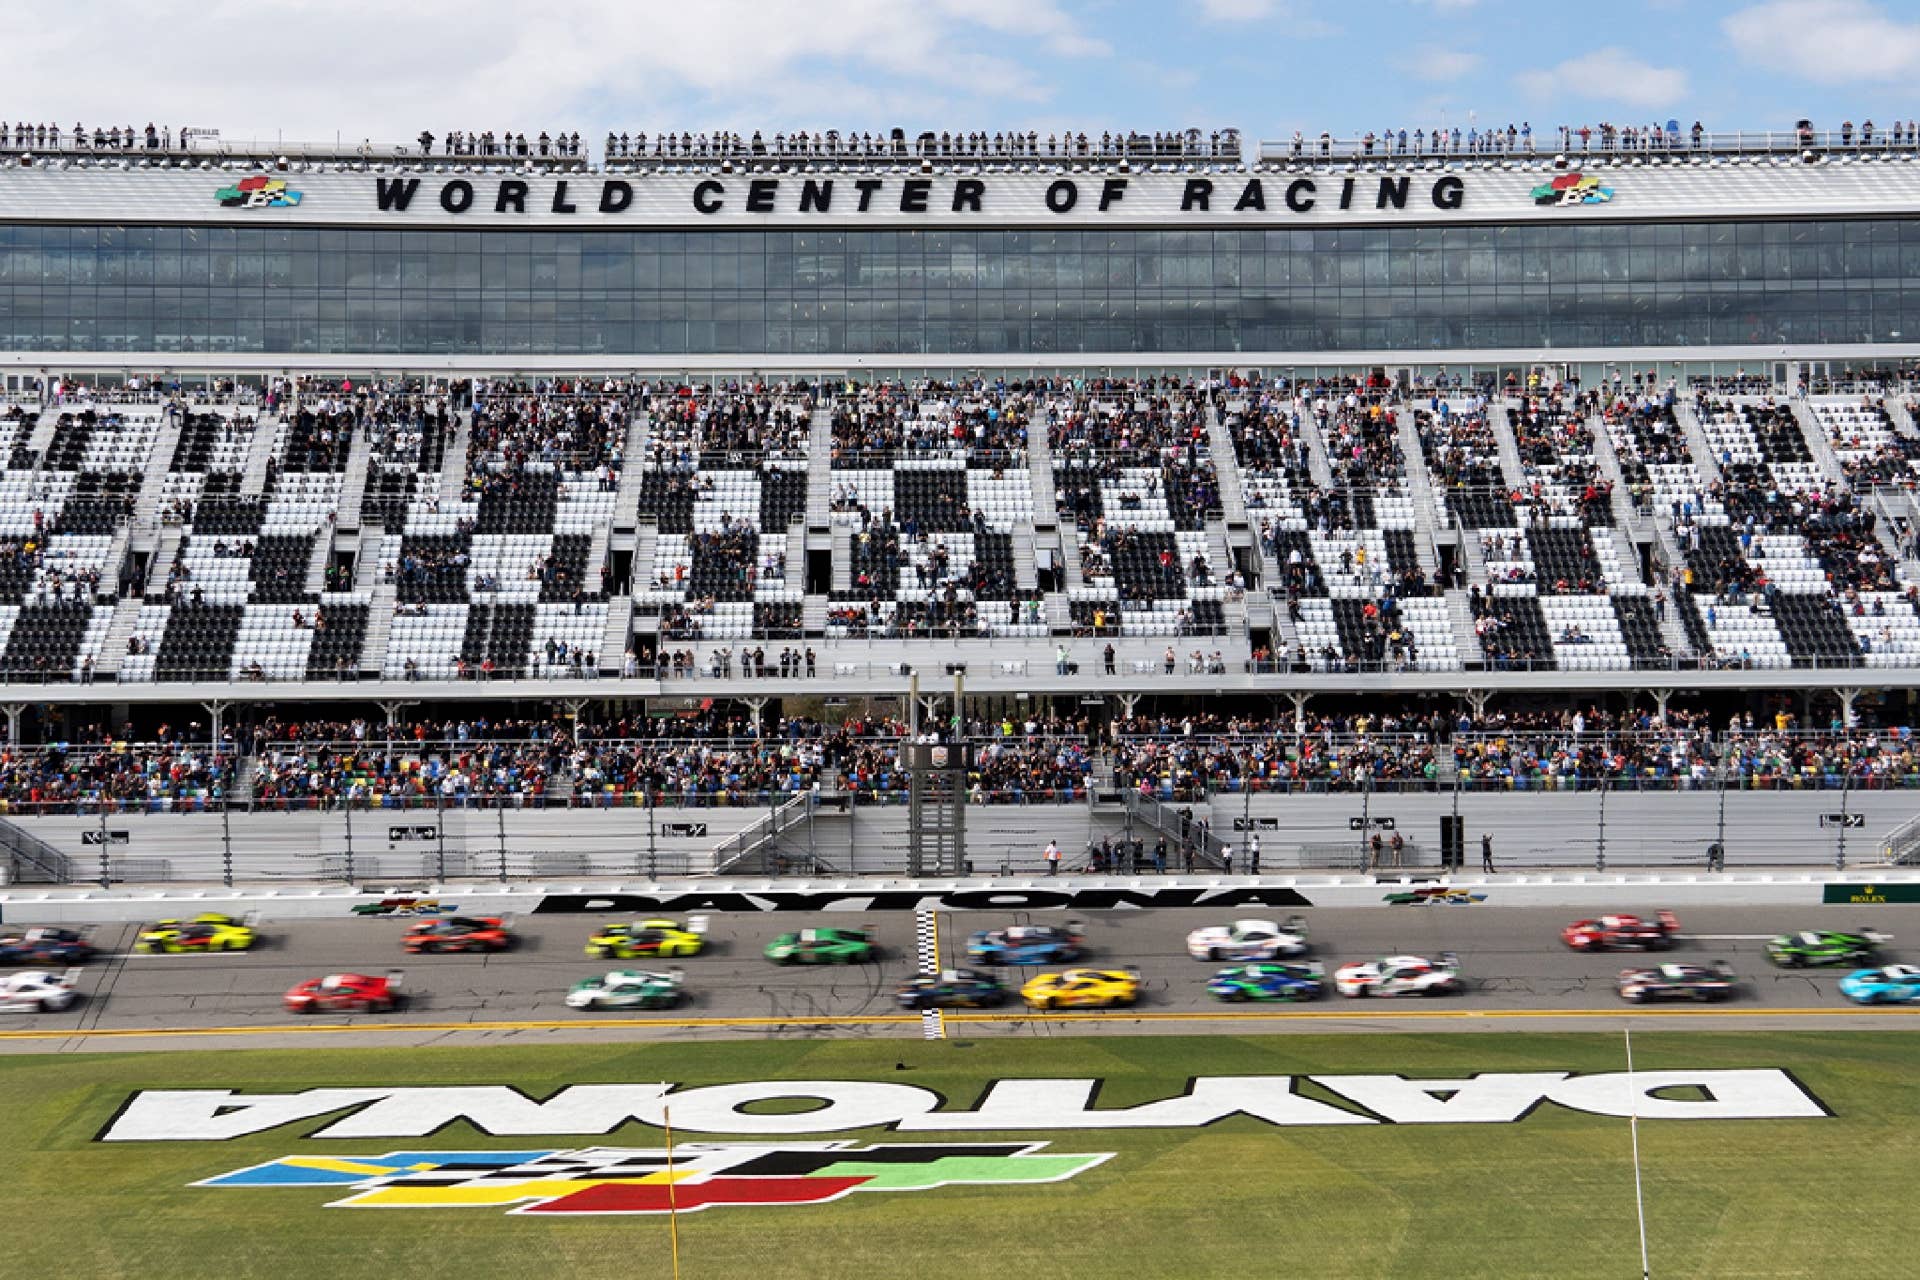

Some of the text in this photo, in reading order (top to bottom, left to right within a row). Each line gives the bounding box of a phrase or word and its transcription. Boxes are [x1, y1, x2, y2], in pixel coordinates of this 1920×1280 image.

[376, 176, 1465, 214] WORLD CENTER OF RACING
[531, 888, 1314, 914] DAYTONA
[1850, 895, 1886, 903] ROLEX
[95, 1068, 1834, 1142] DAYTONA
